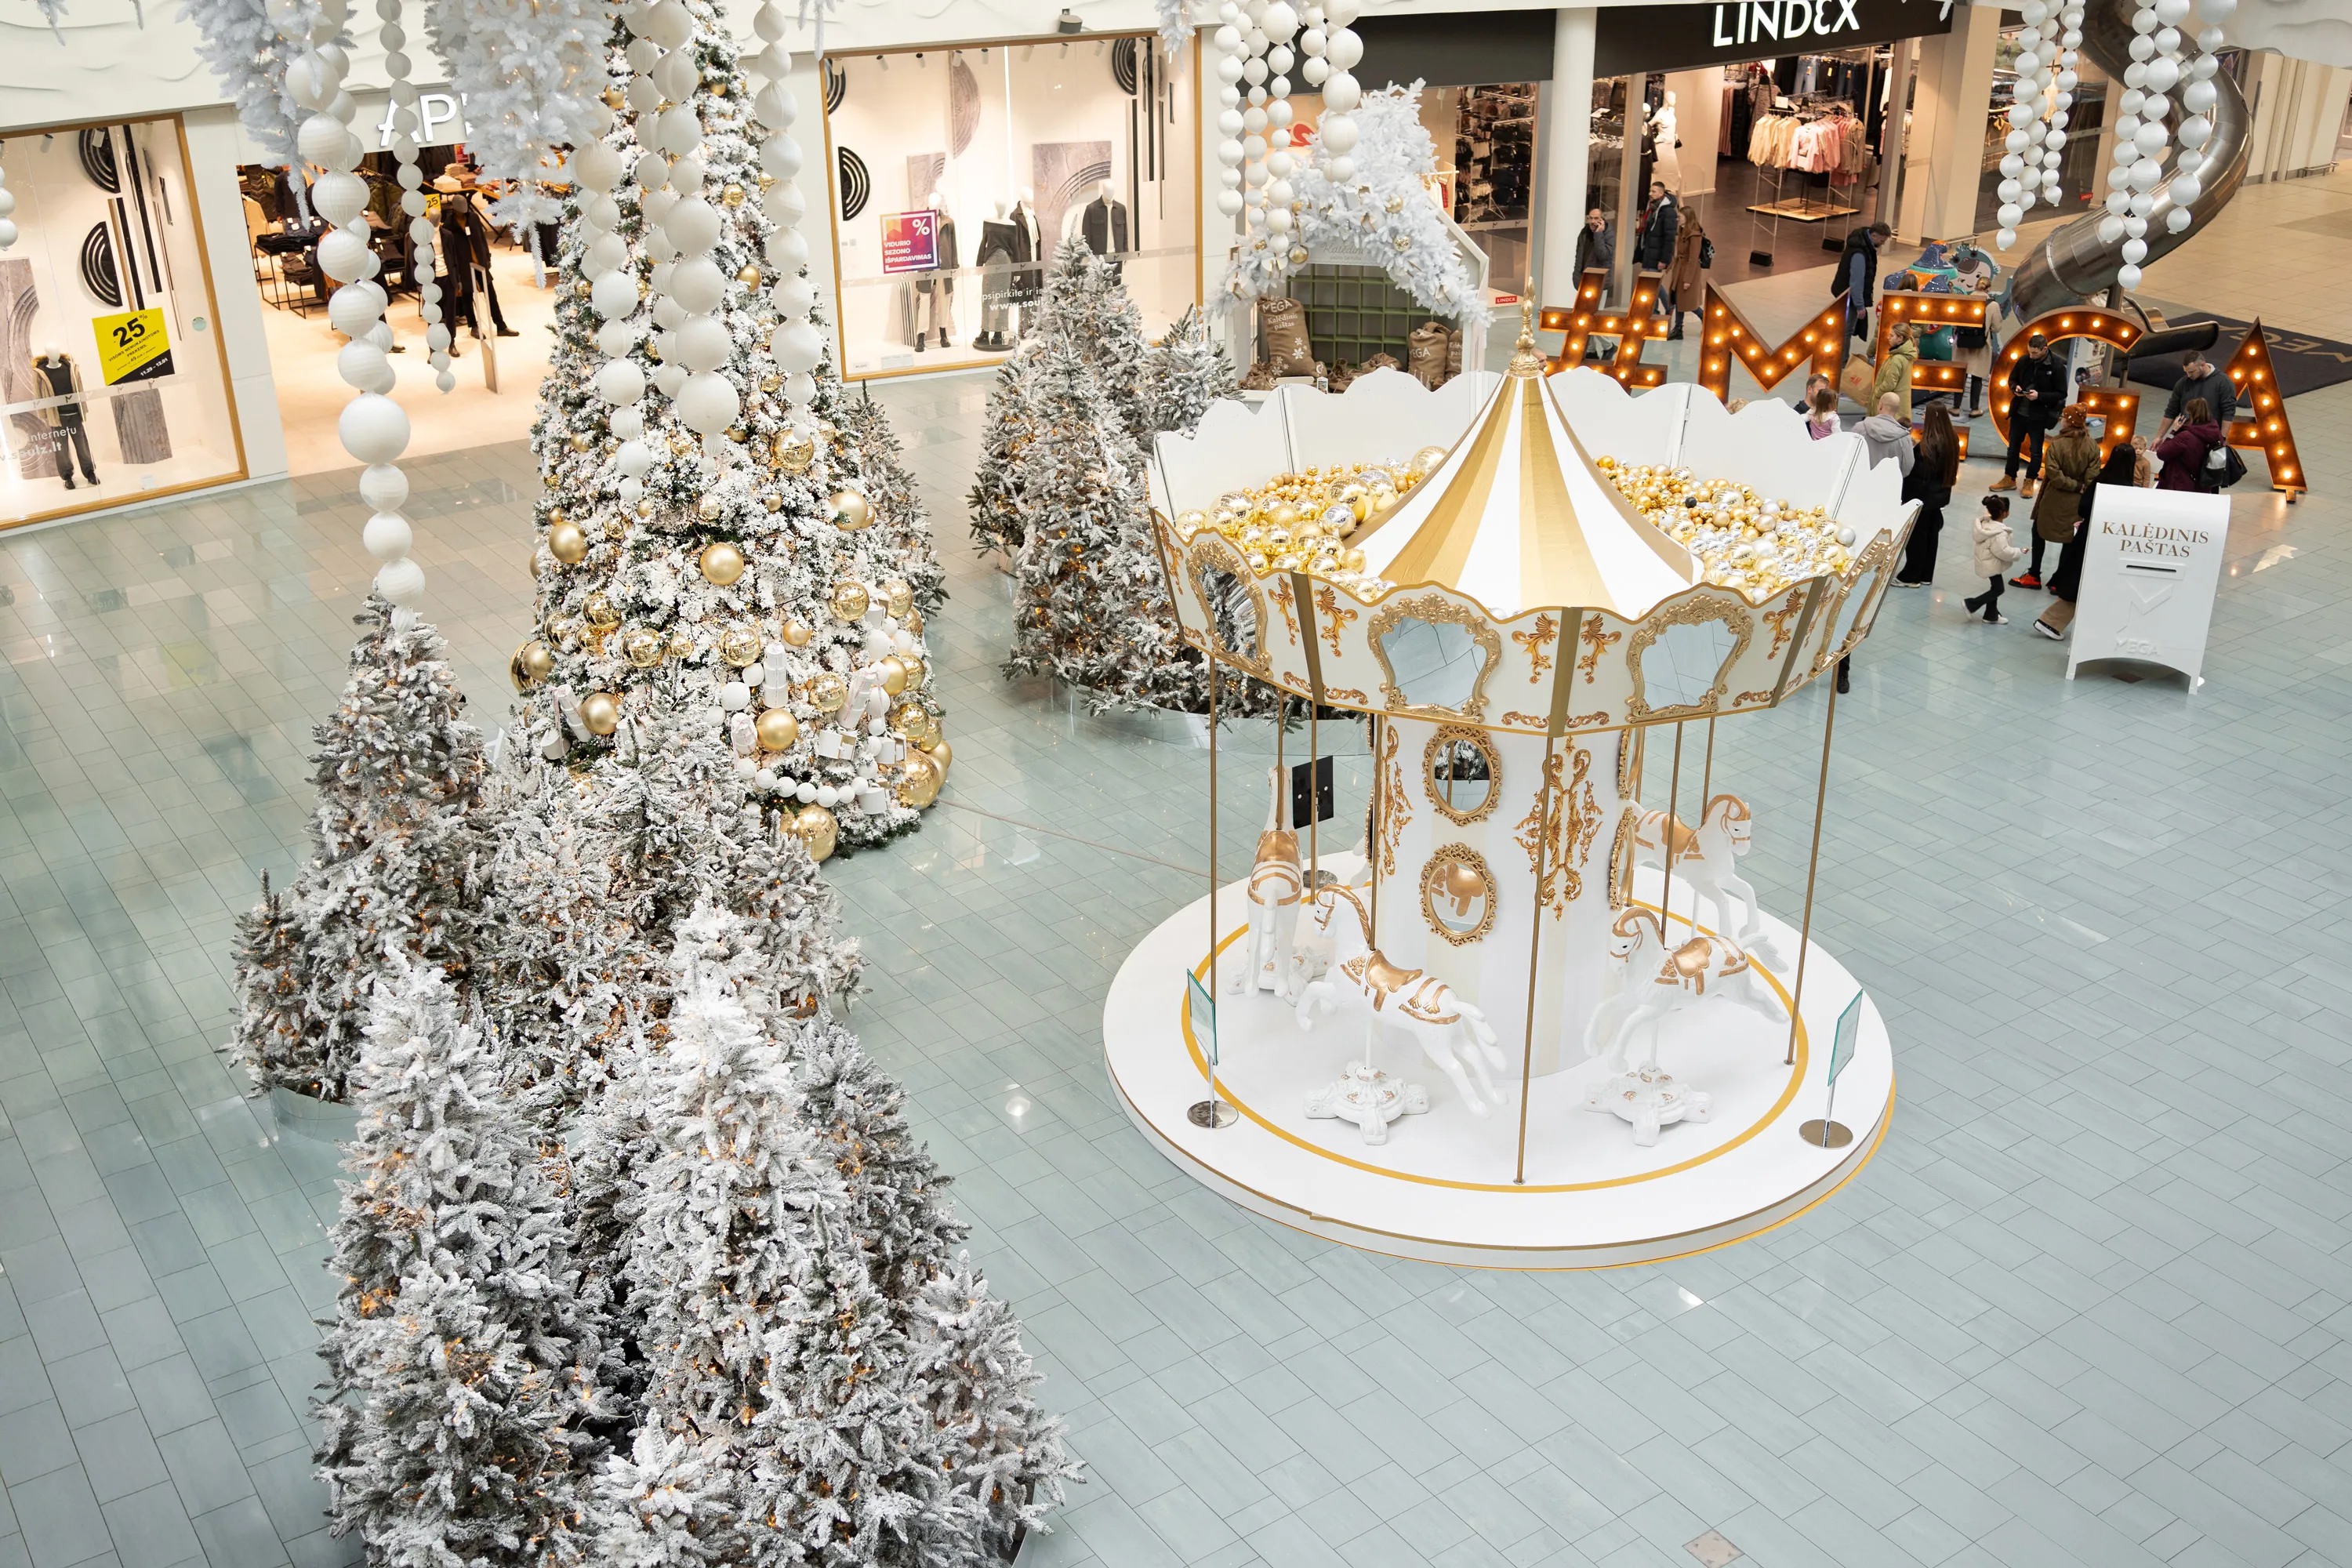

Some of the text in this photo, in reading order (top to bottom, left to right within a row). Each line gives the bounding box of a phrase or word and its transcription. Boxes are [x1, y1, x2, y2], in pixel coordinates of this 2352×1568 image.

[1713, 0, 1860, 47] LINDEX
[912, 218, 931, 236] %
[884, 239, 912, 248] VIDURIO
[884, 253, 932, 264] IŠPARDAVIMAS
[1261, 299, 1293, 314] MEGA
[1267, 312, 1298, 325] Kalėdinis
[1274, 321, 1295, 332] paštas
[2101, 521, 2209, 544] KALĖDINIS
[2118, 539, 2190, 558] PAŠTAS
